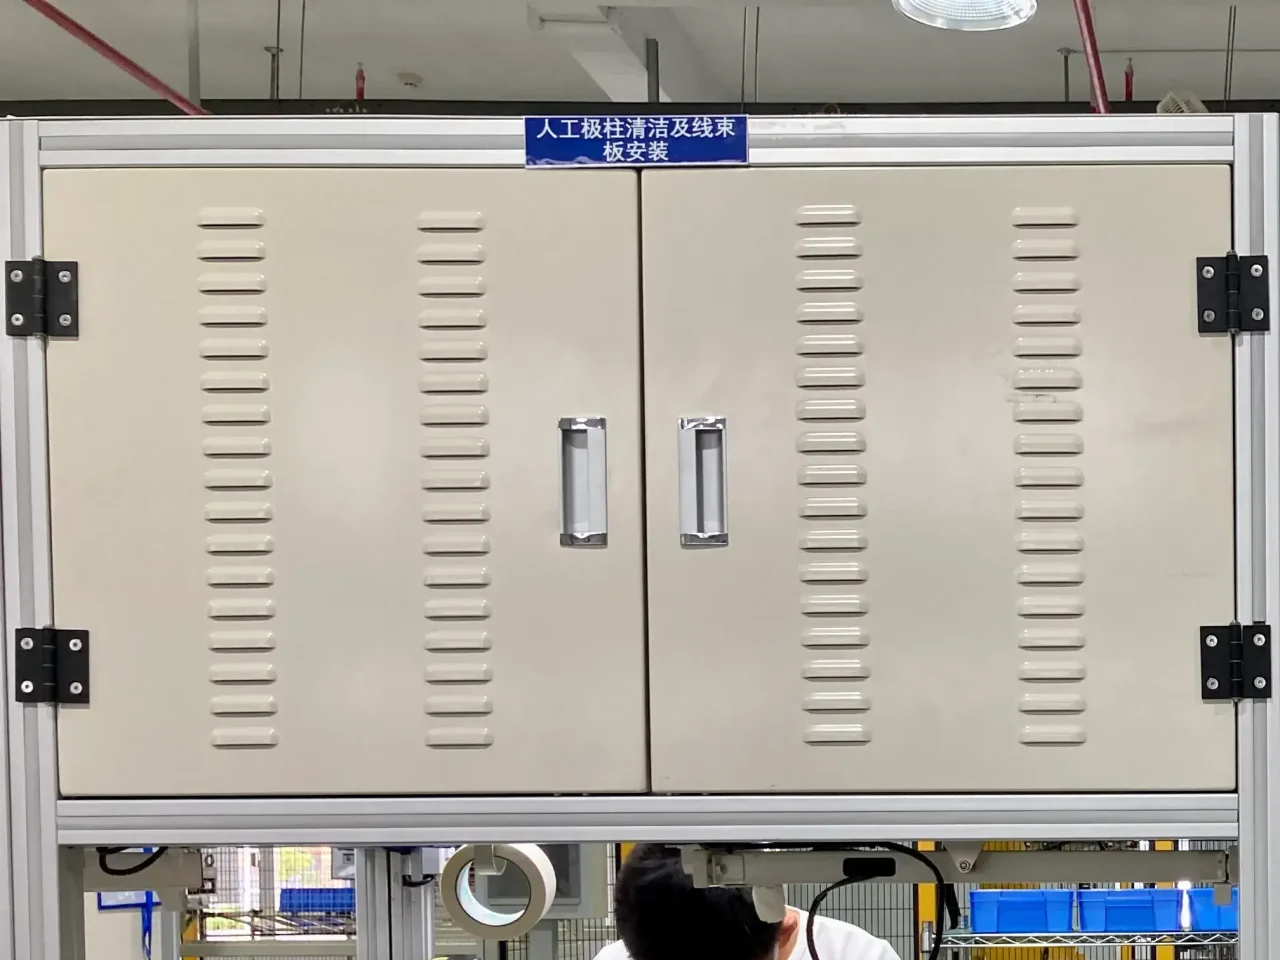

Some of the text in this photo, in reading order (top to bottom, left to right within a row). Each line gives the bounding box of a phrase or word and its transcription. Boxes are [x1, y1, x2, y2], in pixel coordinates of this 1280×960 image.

[536, 117, 736, 139] 人工极柱清洁及线束
[602, 140, 669, 162] 板安装
